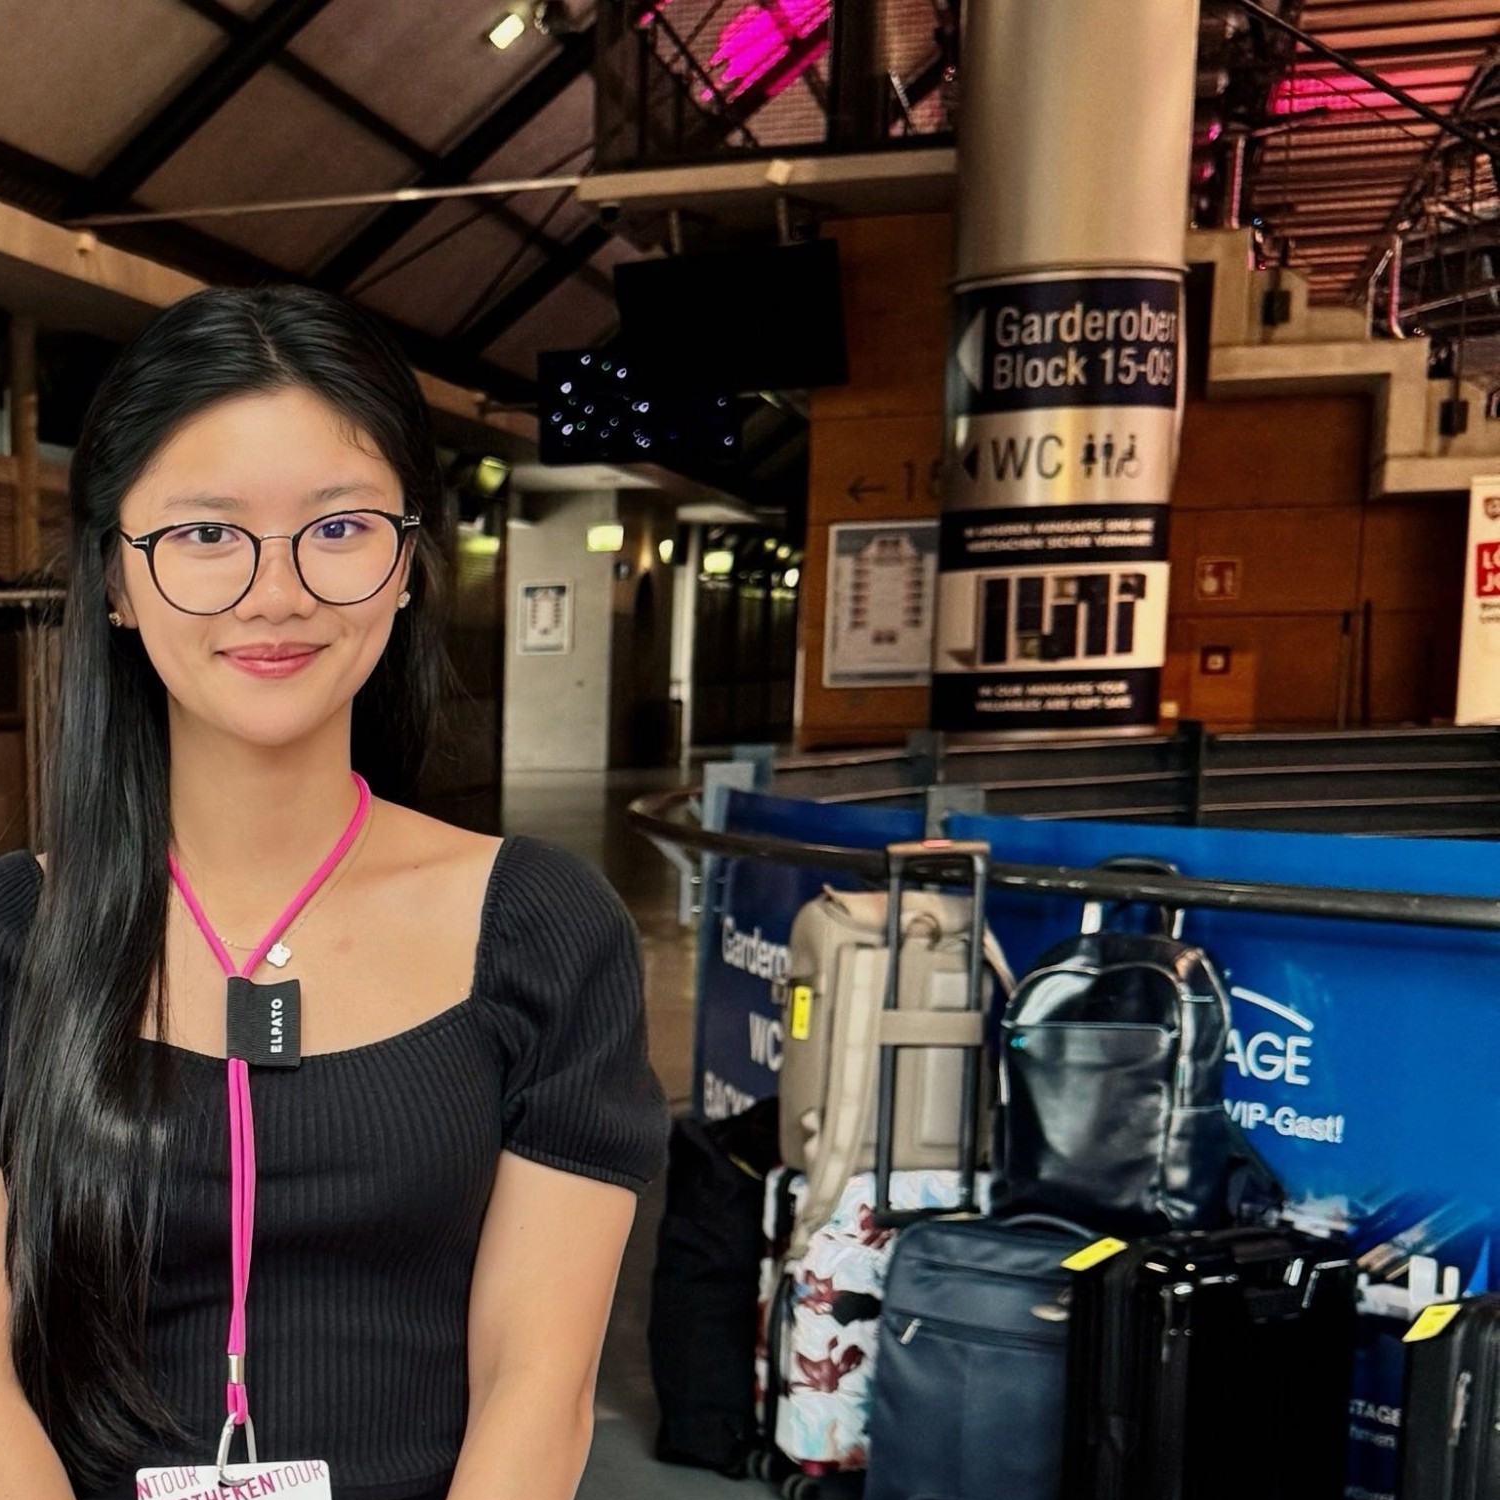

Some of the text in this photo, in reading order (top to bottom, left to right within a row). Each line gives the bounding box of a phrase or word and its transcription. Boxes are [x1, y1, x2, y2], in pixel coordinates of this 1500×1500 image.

[993, 348, 1088, 390] Block
[991, 435, 1063, 479] WC
[270, 998, 283, 1053] ELPATO
[750, 1012, 784, 1073] WC
[1224, 1029, 1313, 1086] AGE
[1223, 1099, 1345, 1143] VIP-Gast!
